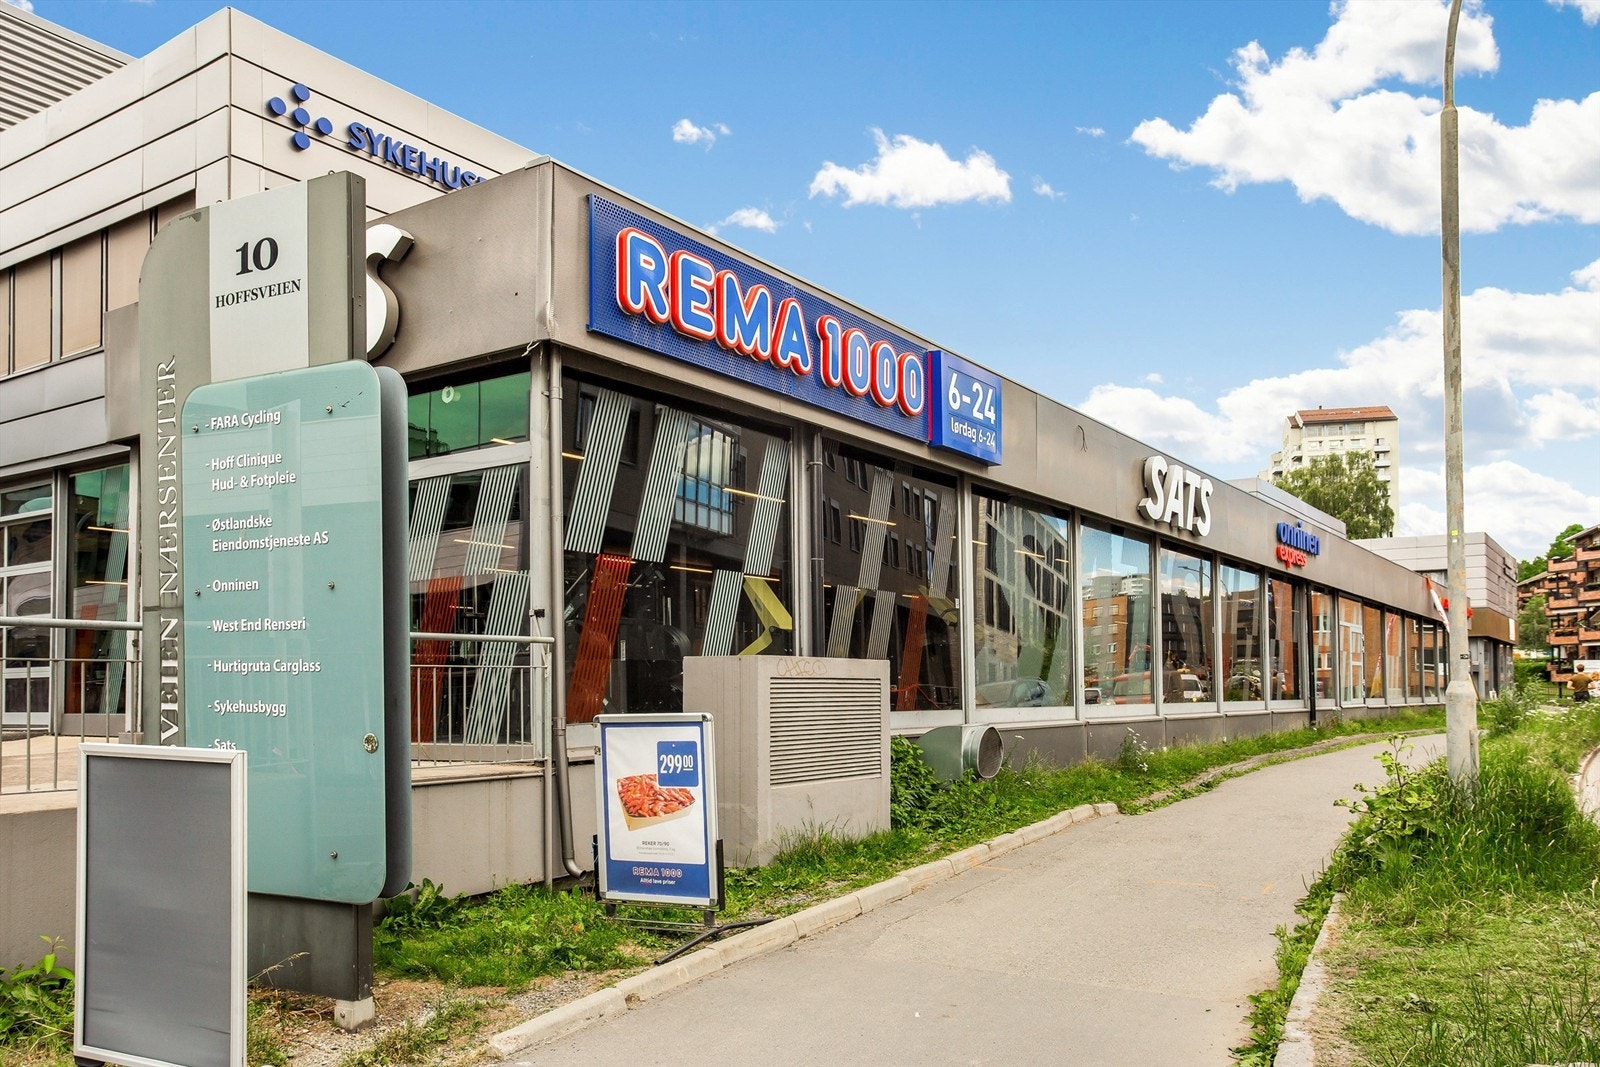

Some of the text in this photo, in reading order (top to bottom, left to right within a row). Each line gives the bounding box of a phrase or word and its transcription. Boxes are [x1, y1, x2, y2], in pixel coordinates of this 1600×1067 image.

[348, 122, 487, 190] SYKEHUS
[235, 237, 279, 276] 10
[215, 279, 302, 308] HOFFSVEIEN
[615, 226, 924, 418] REMA 1000
[948, 372, 996, 425] 6-24
[241, 411, 281, 428] Cycling
[951, 417, 977, 443] lørdag
[236, 452, 283, 468] Clinique
[240, 475, 249, 488] &
[250, 470, 297, 489] Fotpleie
[1137, 455, 1214, 537] SATS
[157, 355, 179, 747] VEIEN NÆRSENTER
[212, 530, 330, 551] Eiendomstjeneste AS
[1277, 521, 1321, 556] onninen
[1276, 545, 1308, 568] express
[241, 619, 262, 632] End
[264, 617, 307, 631] Renseri
[273, 659, 321, 675] Carglass
[632, 867, 682, 878] REMA 1000
